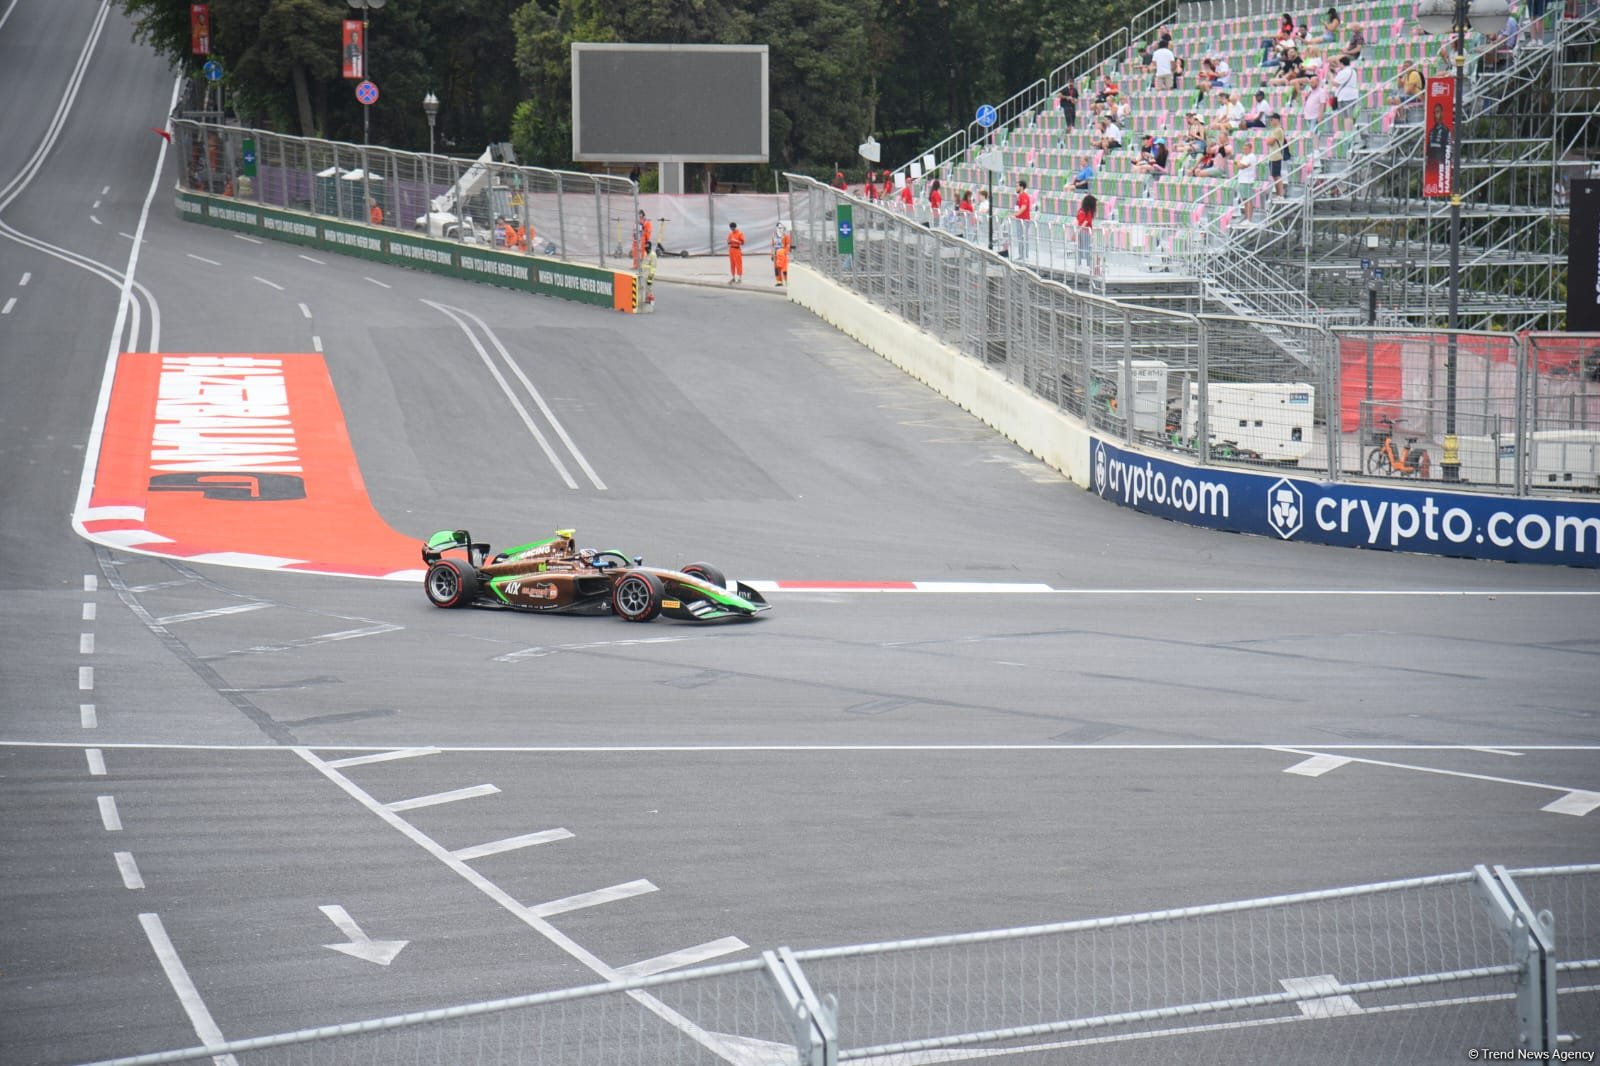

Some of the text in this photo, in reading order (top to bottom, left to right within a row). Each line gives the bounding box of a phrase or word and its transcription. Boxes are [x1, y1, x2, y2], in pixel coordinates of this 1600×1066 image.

[461, 256, 528, 280] WHEN YOU DRIVE NEVER DRINK
[539, 270, 612, 296] WHEN YOU DRIVE NEVER DRINK
[1108, 456, 1230, 518] crypto.com
[1315, 494, 1600, 554] crypto.com
